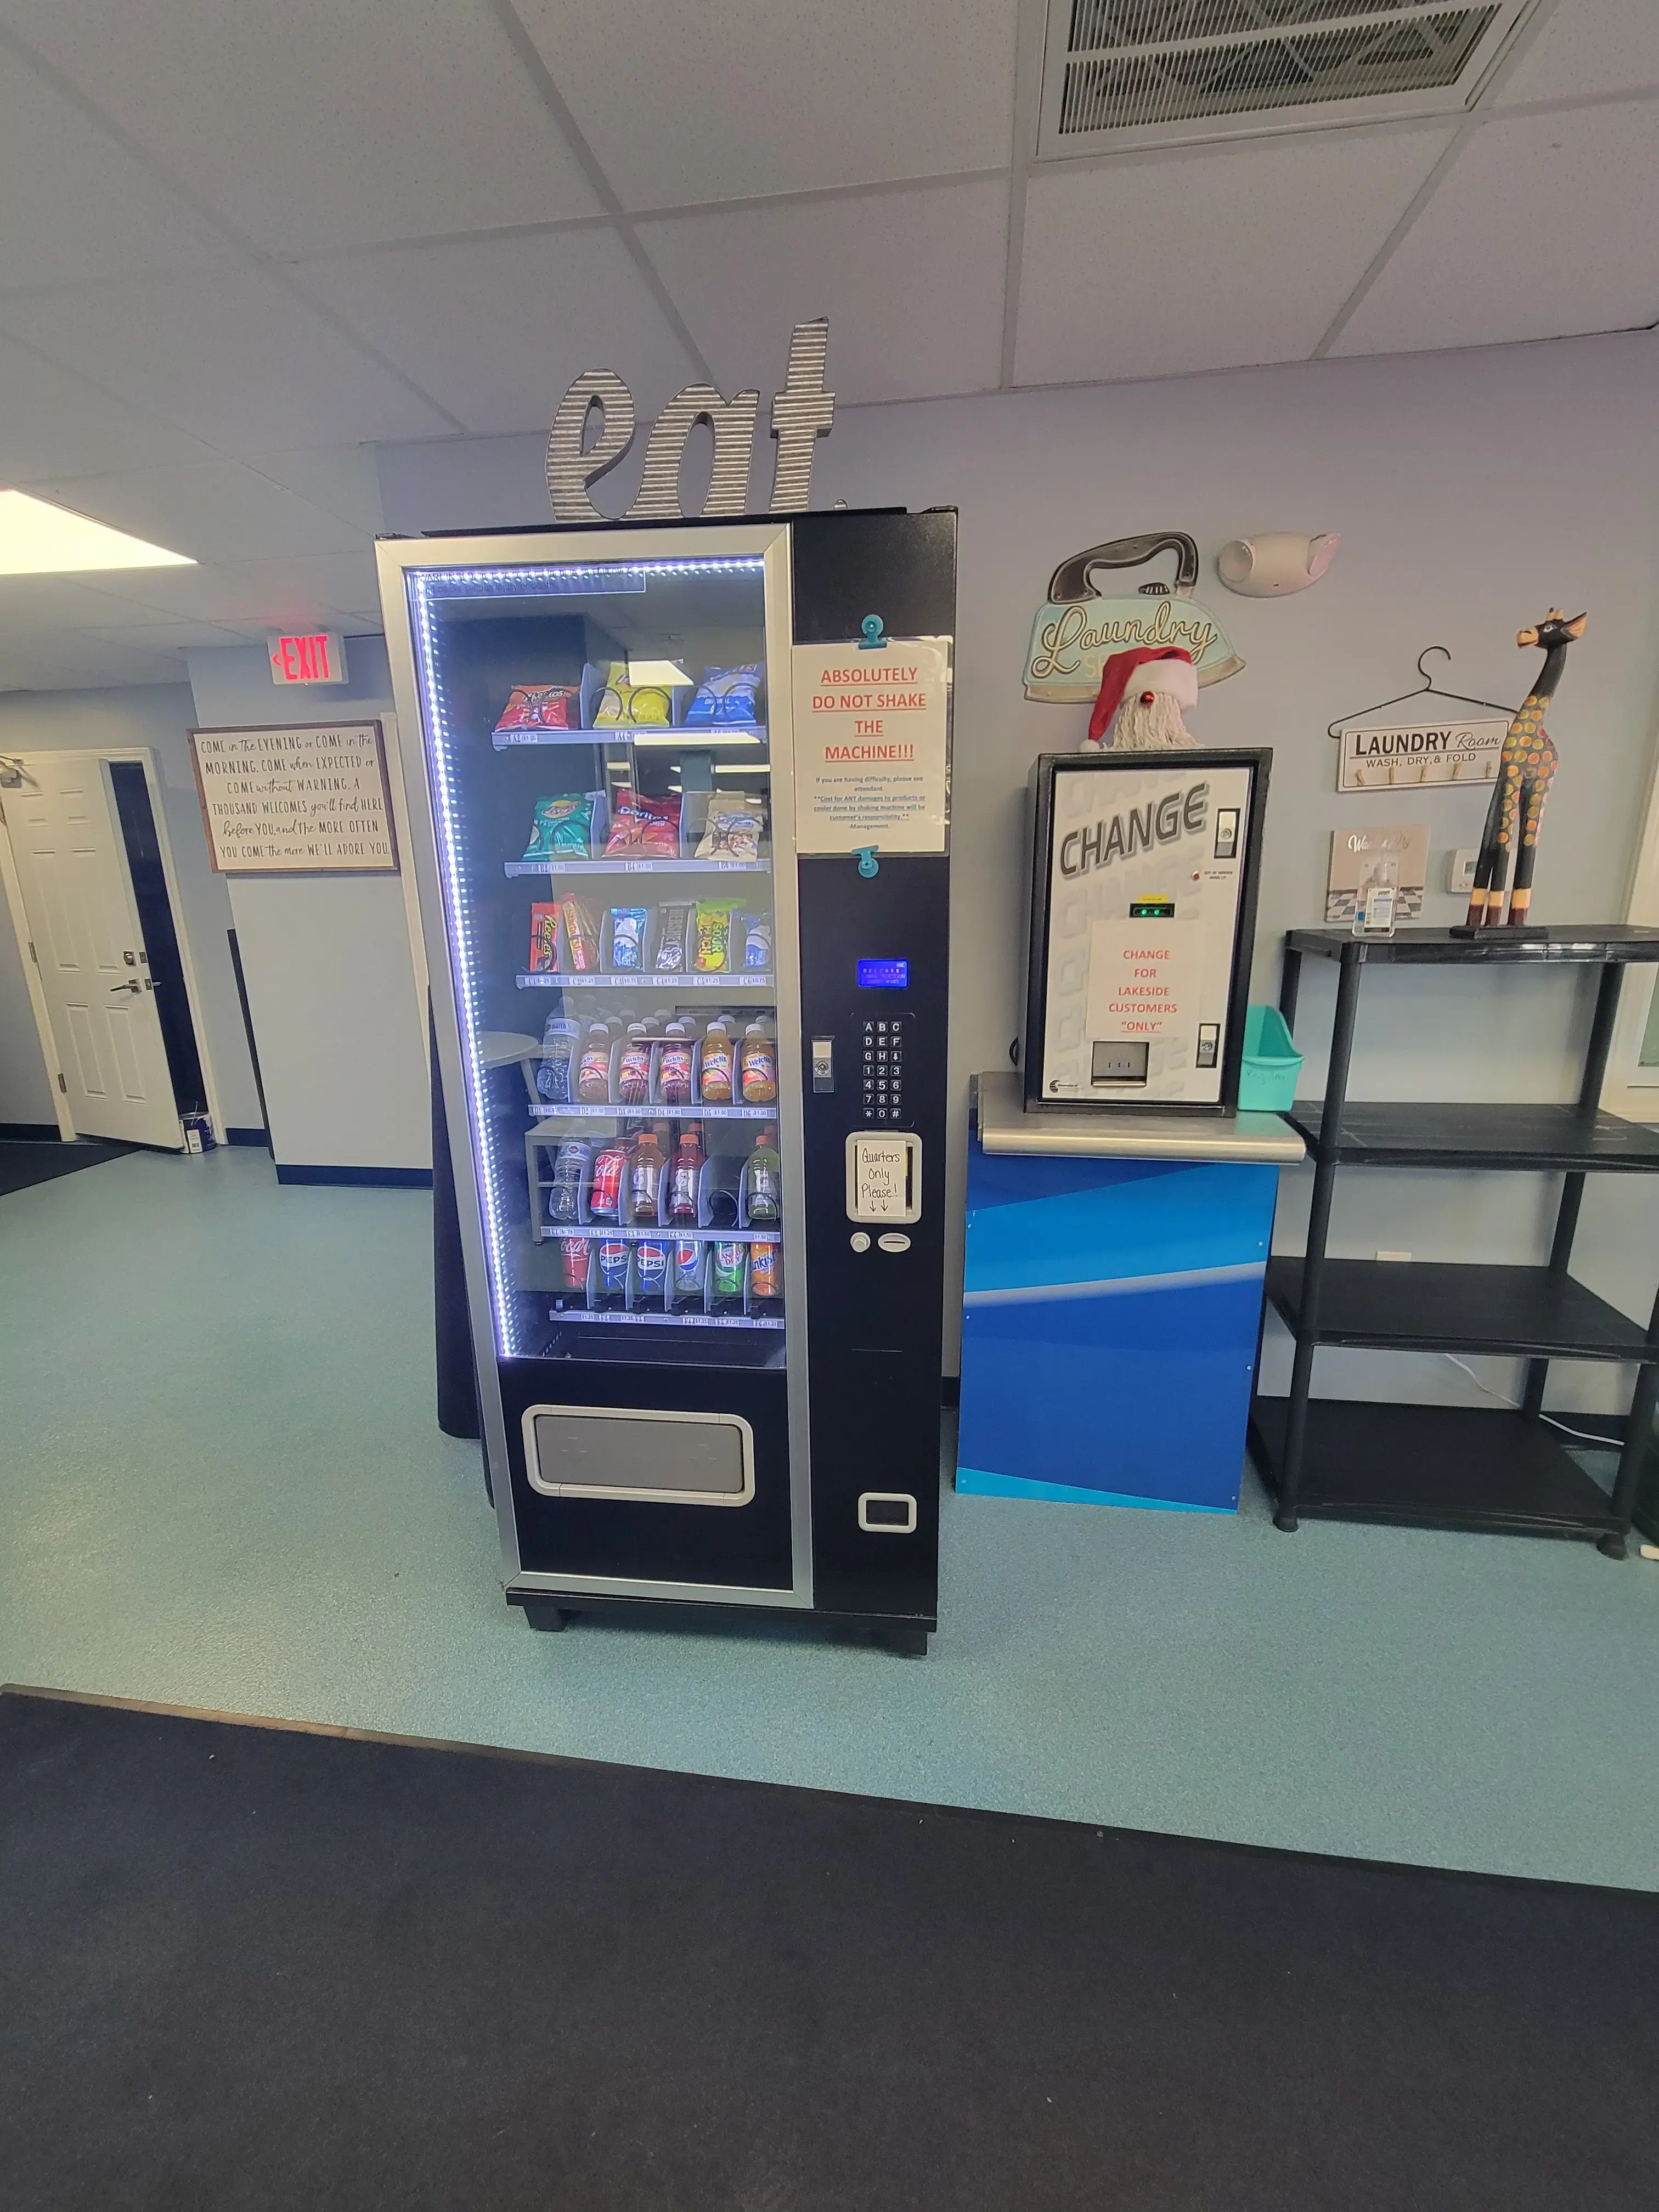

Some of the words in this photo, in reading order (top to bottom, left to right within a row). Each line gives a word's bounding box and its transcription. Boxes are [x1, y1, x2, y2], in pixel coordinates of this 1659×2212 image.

[545, 316, 848, 520] eat
[1031, 601, 1218, 679] Laundry
[279, 635, 329, 680] EXIT
[821, 667, 917, 684] ABSOLUTELY
[812, 696, 835, 709] DO
[840, 695, 873, 708] NOT
[877, 693, 926, 707] SHAKE
[855, 720, 883, 734] THE
[201, 741, 225, 753] COME
[229, 743, 237, 752] in
[315, 735, 342, 748] COME
[1355, 731, 1452, 756] LAUNDRY
[1455, 732, 1501, 749] Room
[825, 744, 913, 759] MACHINE!!!
[261, 759, 286, 771] COME
[289, 757, 313, 771] when
[316, 756, 362, 769] EXPECTED
[1366, 758, 1402, 768] WASH,
[1446, 753, 1476, 763] FOLD
[227, 782, 256, 794] COME
[256, 778, 296, 793] without
[354, 778, 360, 790] A
[212, 803, 257, 815] THOUSAND
[262, 800, 307, 814] WELCOMES
[338, 797, 358, 812] find
[361, 798, 383, 811] HERE
[223, 821, 254, 838] before
[276, 819, 297, 835] and
[319, 821, 344, 833] MORE
[349, 820, 379, 833] OFTEN
[1061, 783, 1208, 877] CHANGE
[220, 847, 237, 858] YOU
[242, 845, 264, 857] COME
[337, 843, 365, 855] ADORE
[712, 921, 724, 953] SOUR
[1123, 950, 1170, 960] CHANGE
[1134, 969, 1156, 978] FOR
[1119, 987, 1170, 996] LAKESIDE
[1108, 1003, 1177, 1013] CUSTOMERS
[865, 1023, 872, 1031] A
[879, 1024, 886, 1032] B
[893, 1024, 900, 1032] C
[866, 1038, 872, 1046] D
[879, 1038, 885, 1046] E
[893, 1038, 899, 1046] F
[665, 1056, 683, 1064] Welch's
[704, 1055, 727, 1068] Welch's
[865, 1052, 872, 1060] G
[879, 1052, 886, 1060] H
[893, 1067, 900, 1075] 3
[879, 1081, 886, 1090] 5
[893, 1081, 899, 1090] 6
[879, 1096, 885, 1104] 8
[893, 1096, 899, 1104] 9
[879, 1110, 886, 1118] 0
[862, 1148, 900, 1163] Quarters
[868, 1168, 889, 1186] Only
[861, 1183, 897, 1198] Please!
[601, 1255, 628, 1264] PEPS
[752, 1250, 776, 1271] unkist
